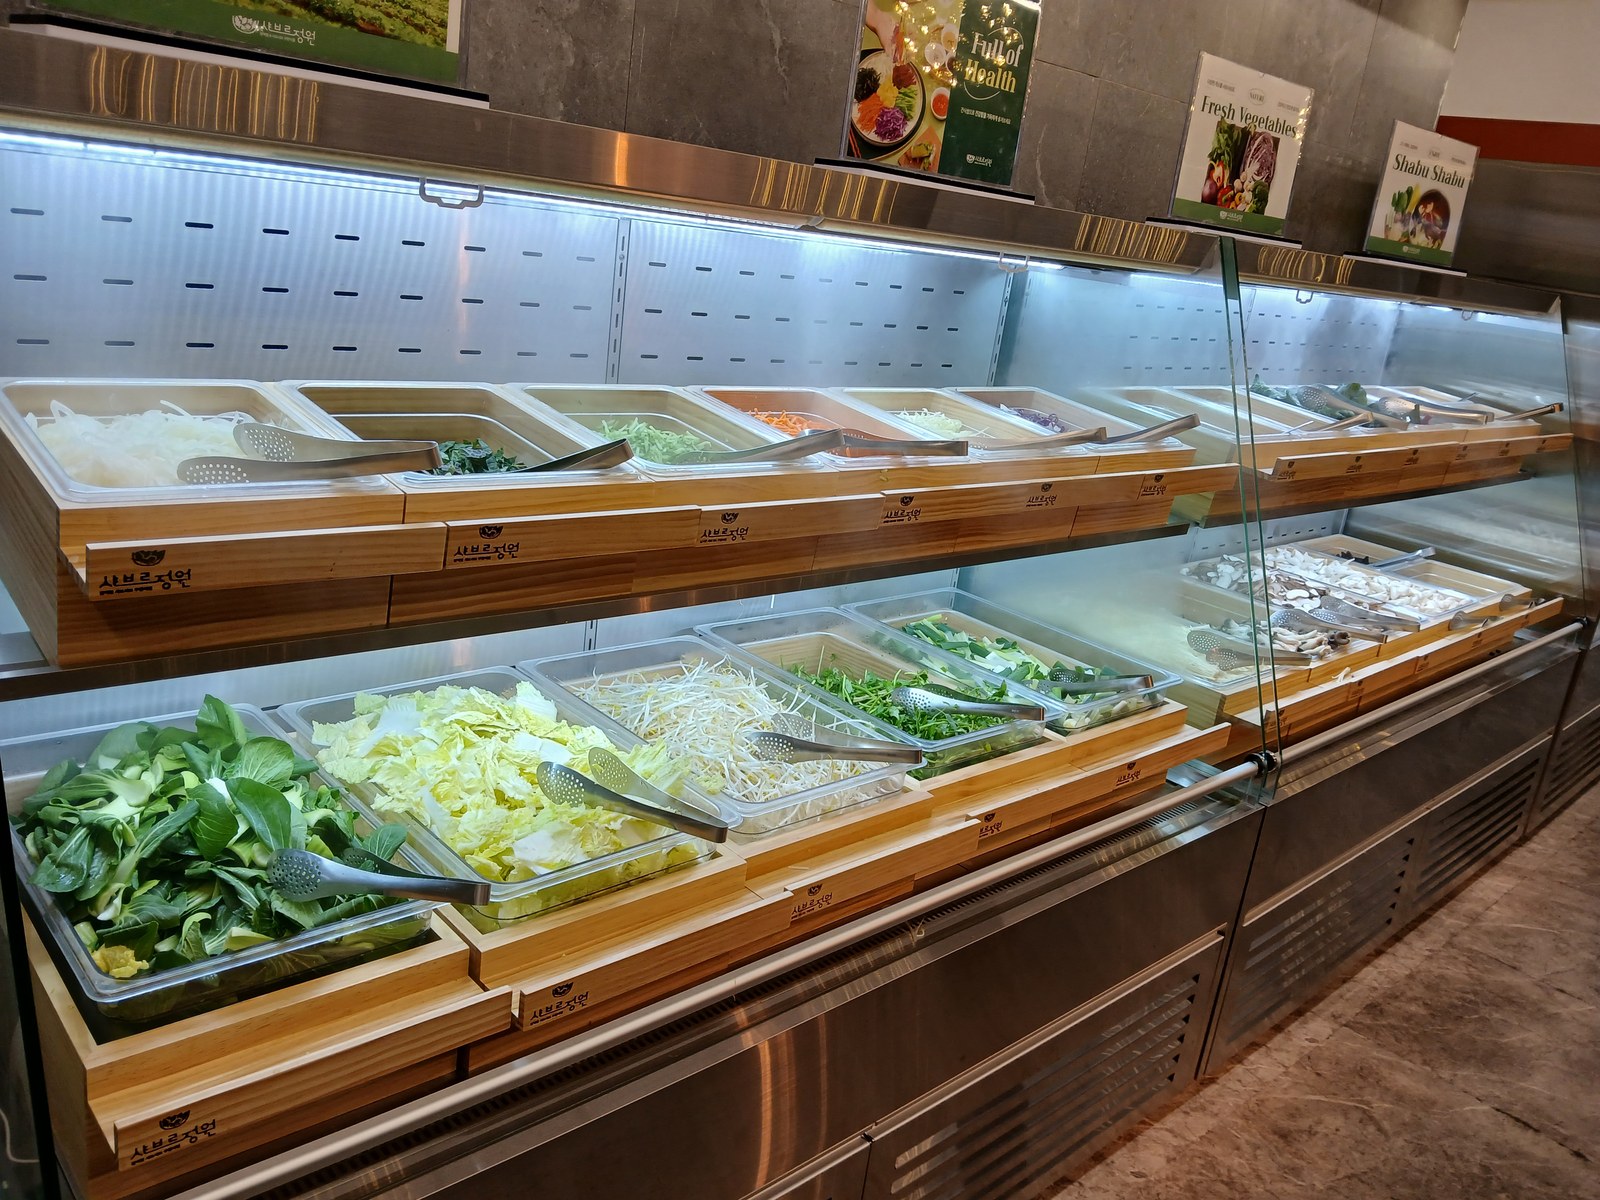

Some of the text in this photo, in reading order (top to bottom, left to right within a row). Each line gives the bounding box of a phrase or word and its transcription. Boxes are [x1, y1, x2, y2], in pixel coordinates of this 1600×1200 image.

[971, 32, 1024, 67] Full of
[964, 58, 1017, 94] Health
[1201, 95, 1236, 120] Fresh
[1239, 106, 1298, 138] Vegetables
[1393, 153, 1430, 178] Shabu
[1431, 164, 1466, 188] Shabu
[99, 568, 192, 590] 샤브르정원
[130, 1118, 217, 1160] 샤브르정원
